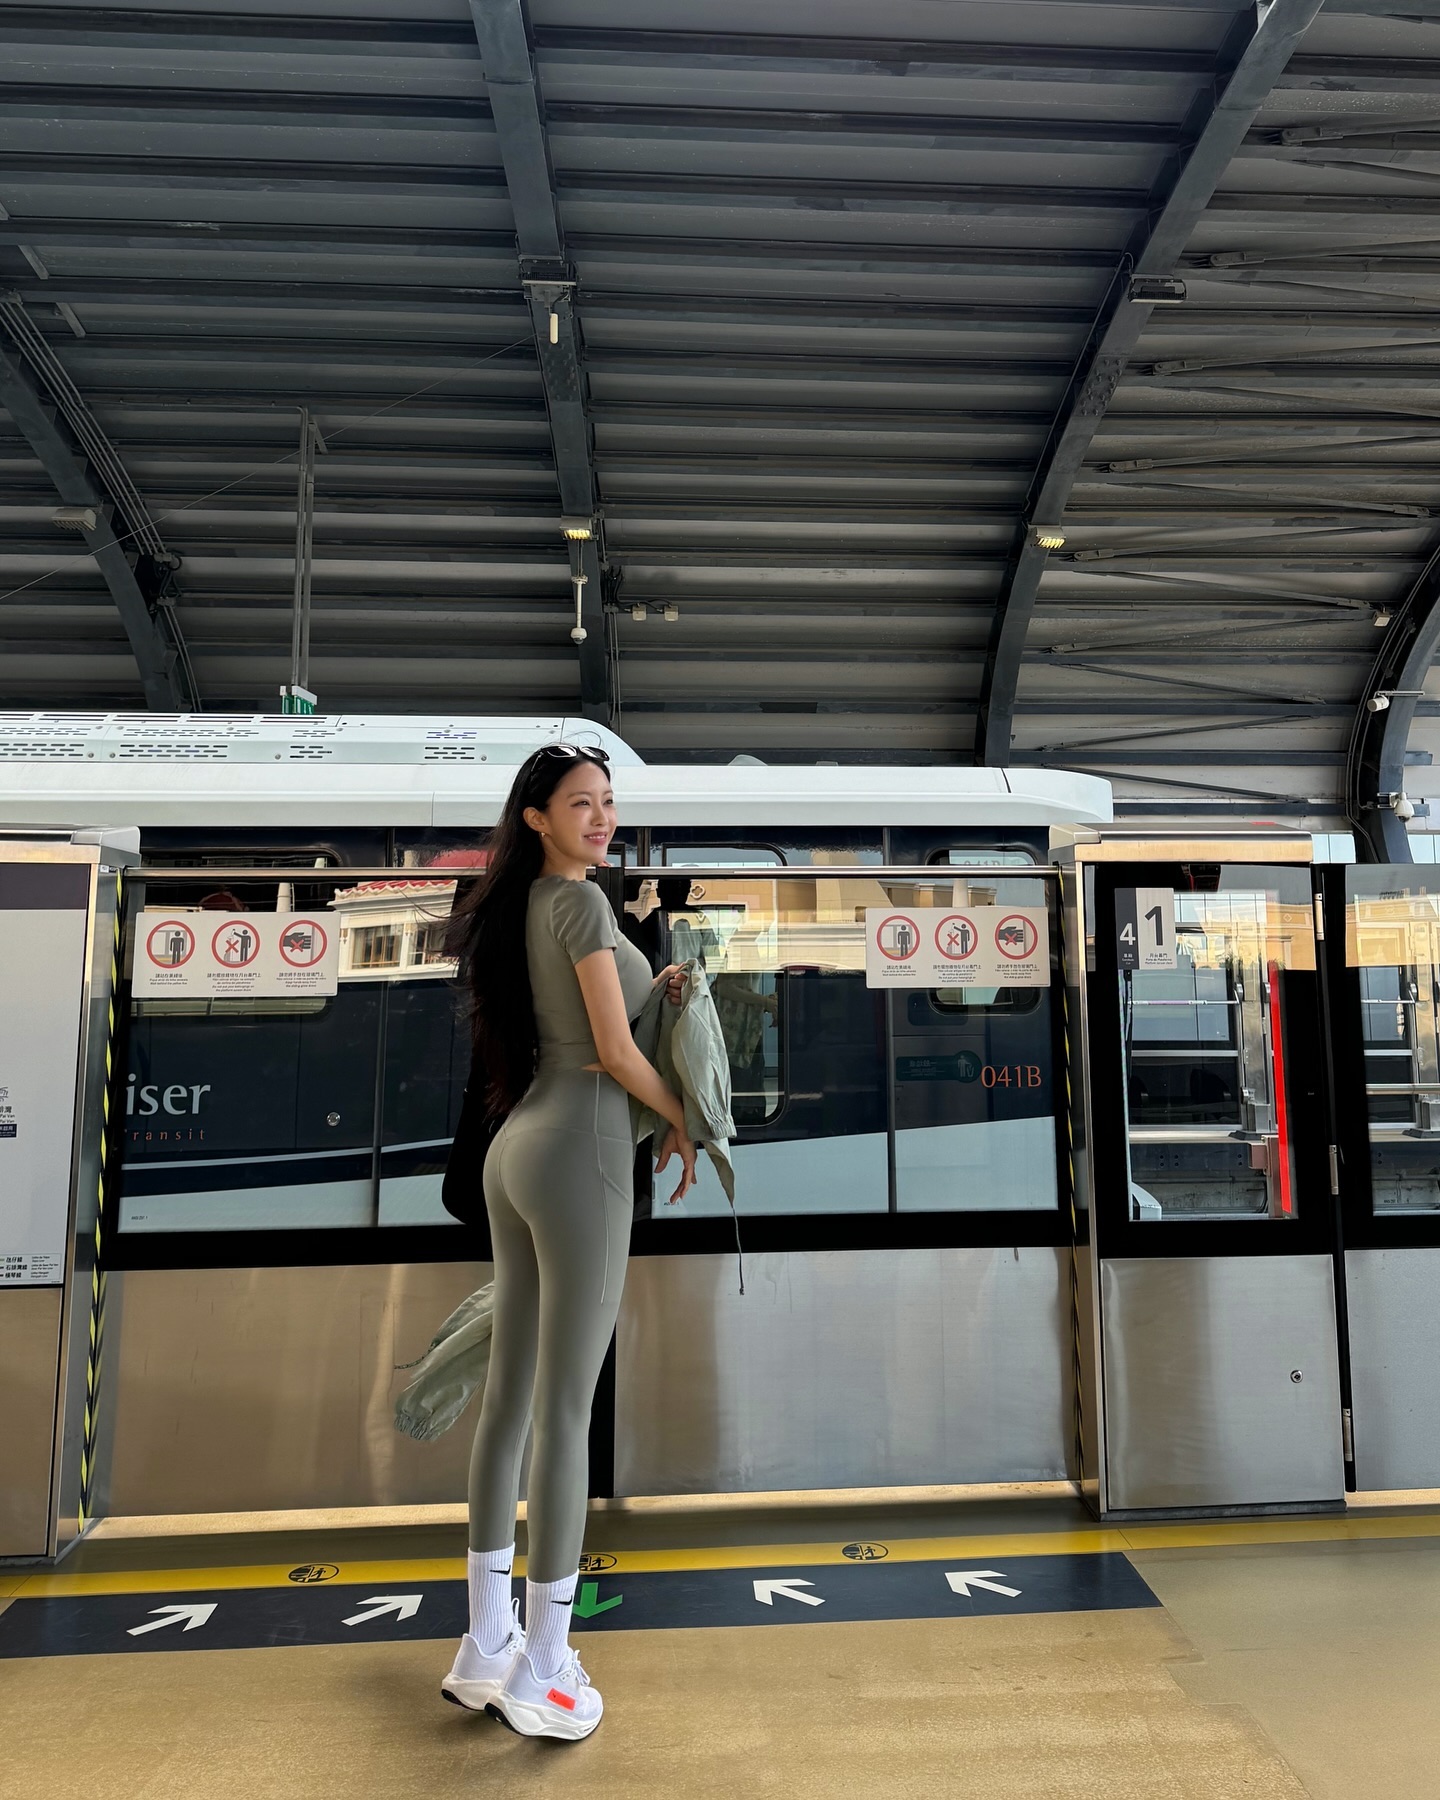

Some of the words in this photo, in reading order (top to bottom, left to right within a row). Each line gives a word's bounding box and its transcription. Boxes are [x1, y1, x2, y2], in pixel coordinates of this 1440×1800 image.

[1119, 922, 1136, 946] 4
[1144, 905, 1164, 946] 1
[981, 1065, 1042, 1088] 041B
[125, 1073, 211, 1115] iser
[124, 1128, 205, 1141] ransit
